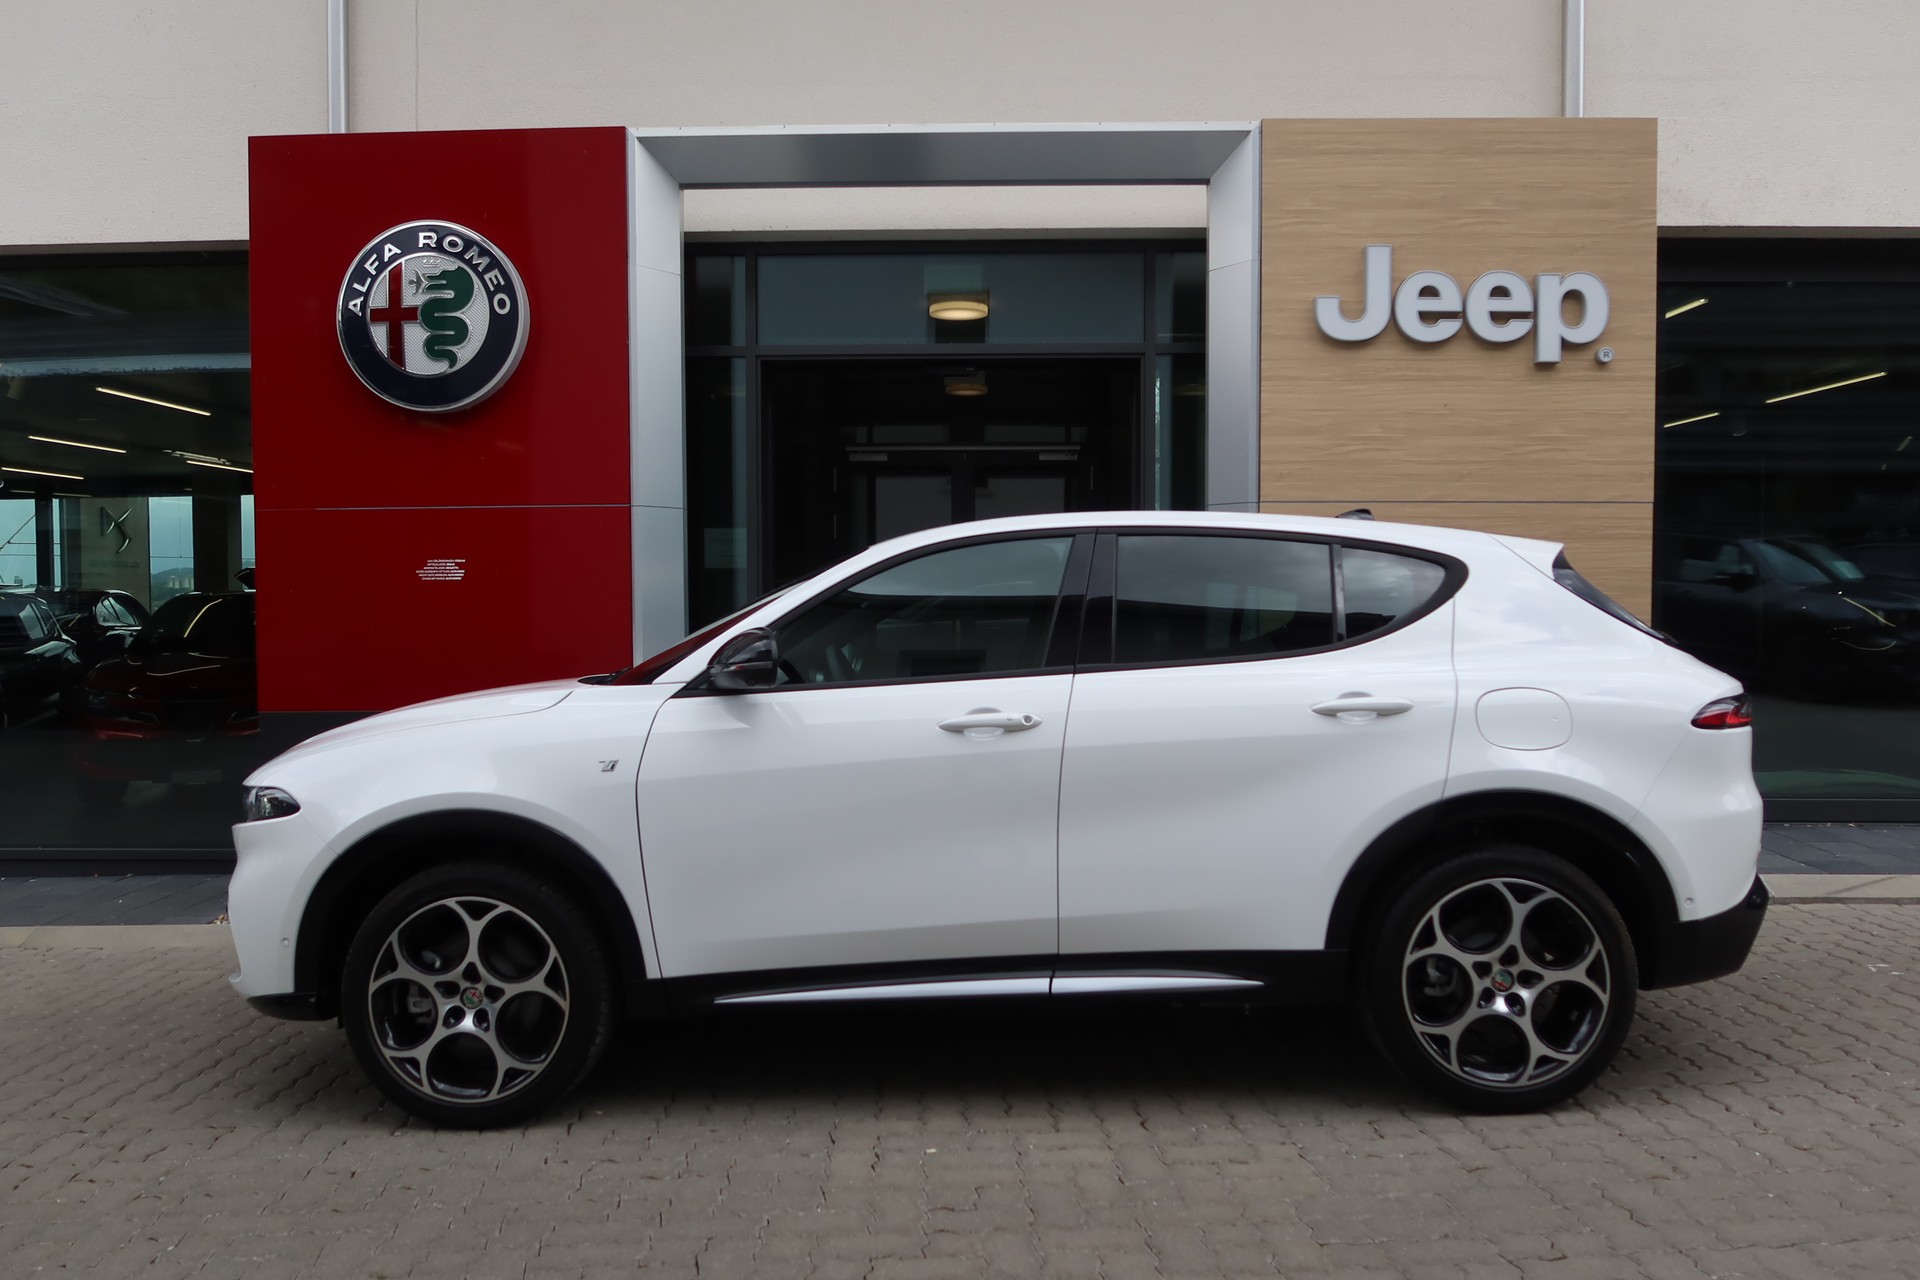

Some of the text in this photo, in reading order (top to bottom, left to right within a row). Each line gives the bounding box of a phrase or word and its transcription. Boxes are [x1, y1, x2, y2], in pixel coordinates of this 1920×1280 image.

[348, 231, 511, 317] ALFA ROMEO
[1314, 243, 1611, 365] Jeep
